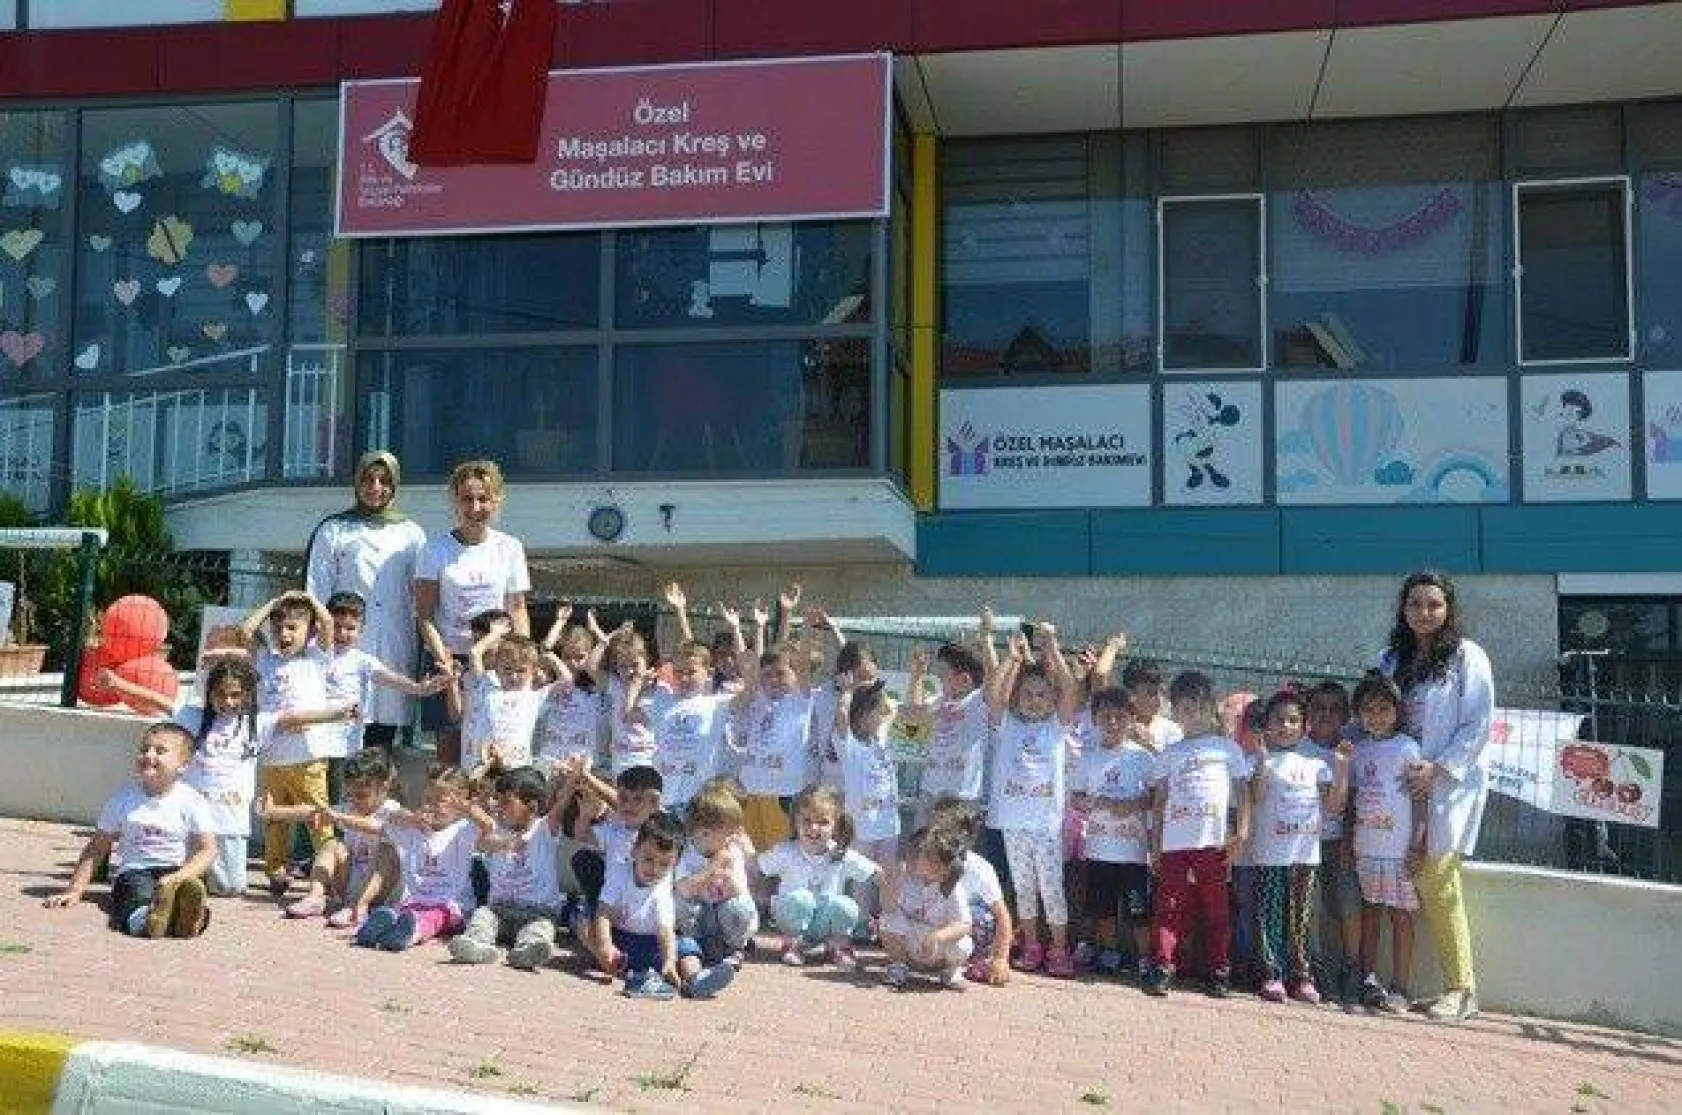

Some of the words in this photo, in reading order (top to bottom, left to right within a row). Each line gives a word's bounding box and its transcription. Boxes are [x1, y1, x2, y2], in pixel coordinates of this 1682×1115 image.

[634, 97, 690, 123] Özel
[673, 131, 729, 157] Kreş
[736, 132, 767, 151] ve
[550, 166, 645, 191] Gündüz
[650, 162, 728, 187] Bakım
[735, 160, 774, 182] Evi
